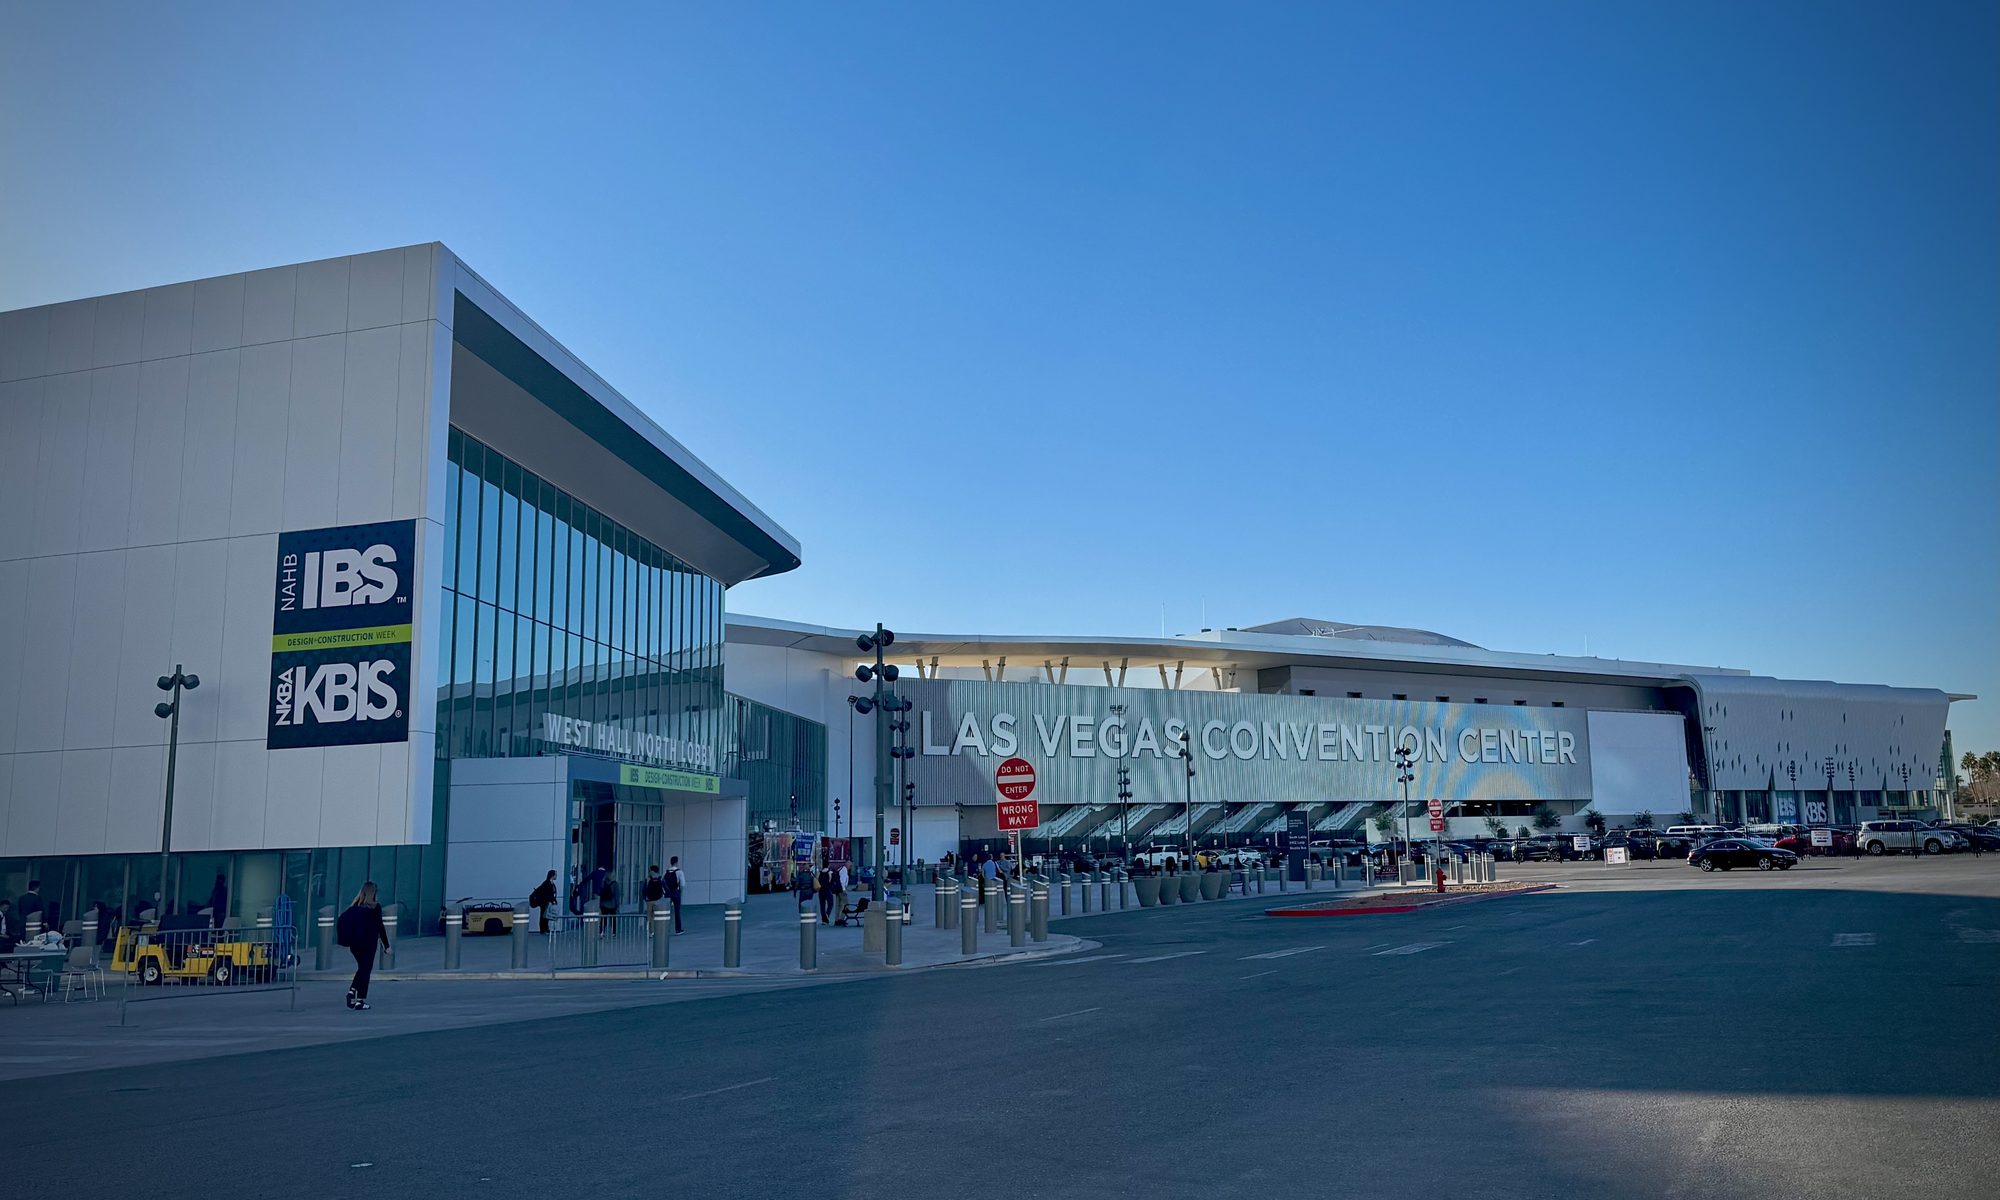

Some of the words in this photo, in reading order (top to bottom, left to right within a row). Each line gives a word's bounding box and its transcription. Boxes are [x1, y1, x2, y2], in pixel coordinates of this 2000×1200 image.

[280, 553, 298, 611] NAHB
[302, 543, 398, 610] IBS
[376, 630, 397, 640] WEEK
[275, 667, 294, 726] NKBA
[293, 659, 398, 725] KBIS
[544, 713, 592, 747] WEST
[595, 722, 633, 755] HALL
[635, 731, 677, 762] NORTH
[681, 739, 715, 768] LOBBY
[922, 710, 1018, 757] LAS
[1033, 714, 1187, 759] VEGAS
[1202, 719, 1448, 762] CONVENTION
[1459, 727, 1577, 764] CENTER
[1001, 766, 1012, 774] DO
[1015, 765, 1029, 773] NOT
[1005, 785, 1028, 794] ENTER
[1002, 804, 1034, 815] WRONG
[1008, 816, 1028, 826] WAY
